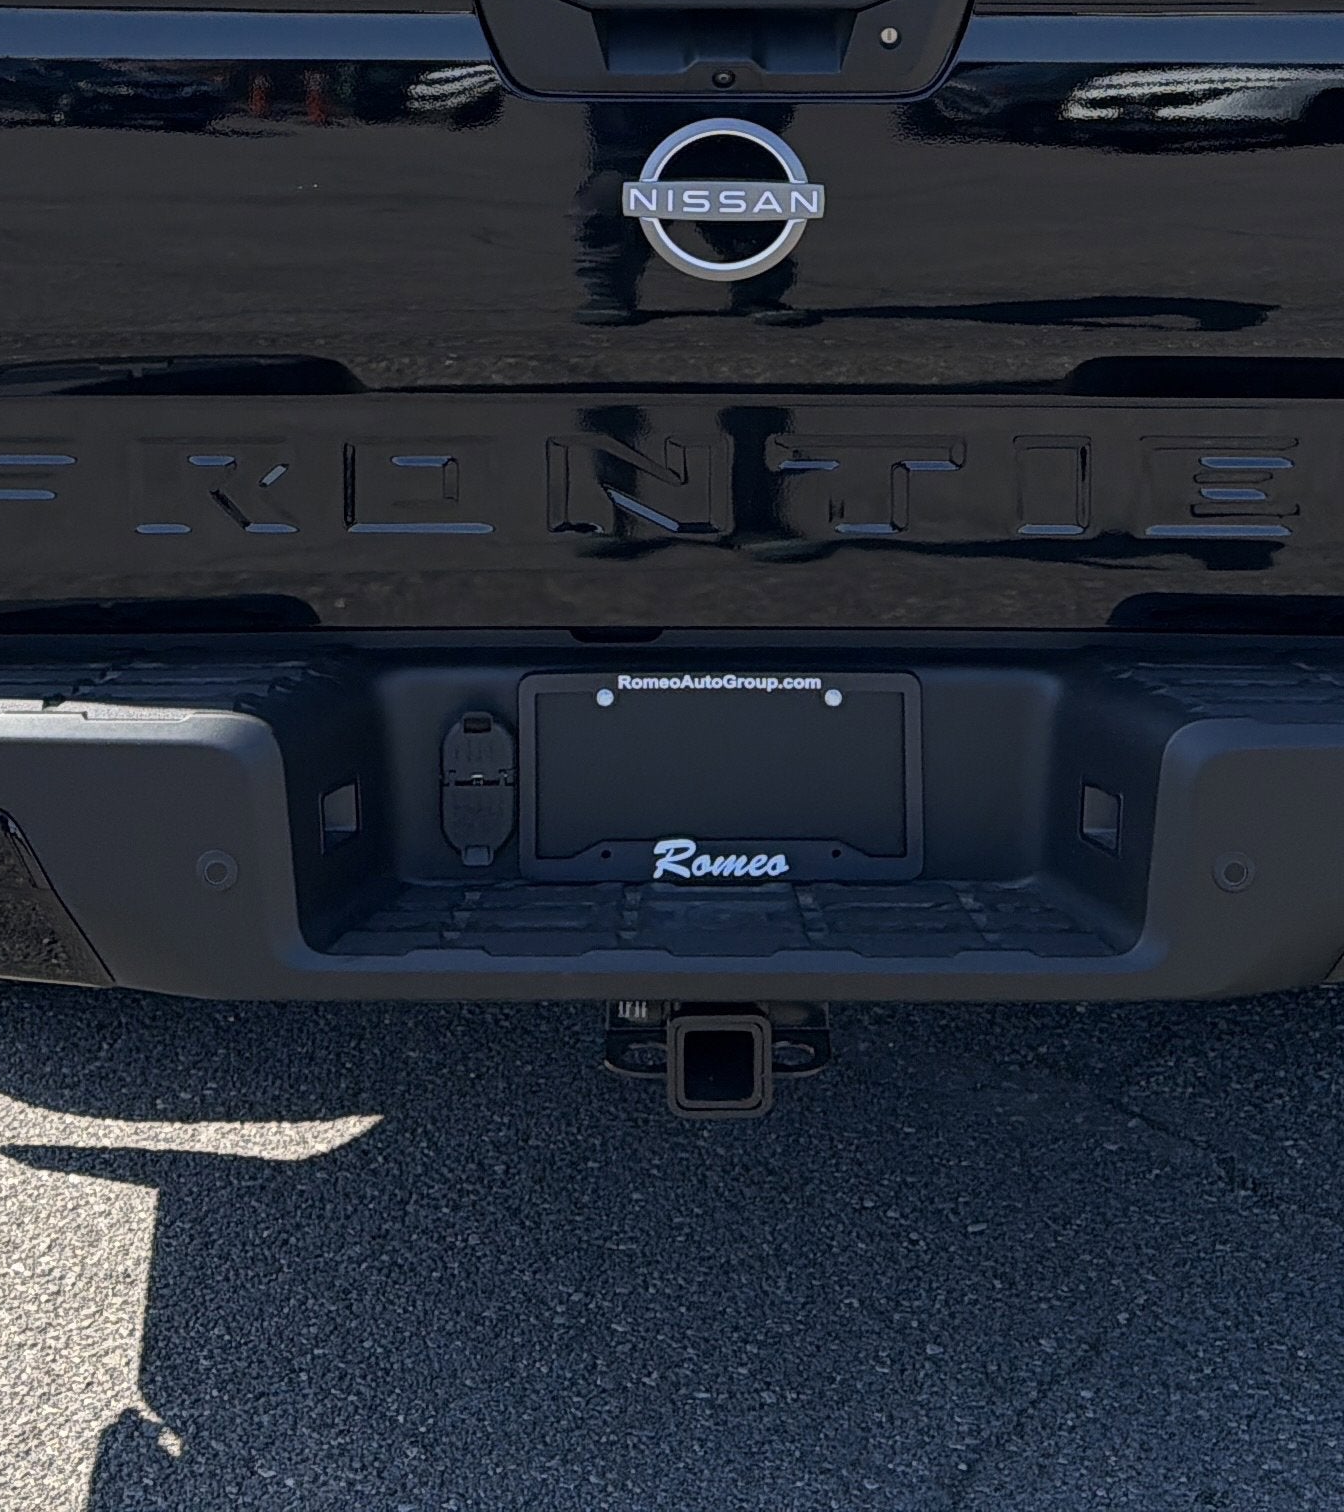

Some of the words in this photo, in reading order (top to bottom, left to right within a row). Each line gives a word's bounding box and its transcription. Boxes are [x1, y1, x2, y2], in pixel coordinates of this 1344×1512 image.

[628, 188, 819, 214] NISSAN
[617, 674, 823, 693] RomeoAutoGroup.com
[652, 838, 791, 880] Romeo
